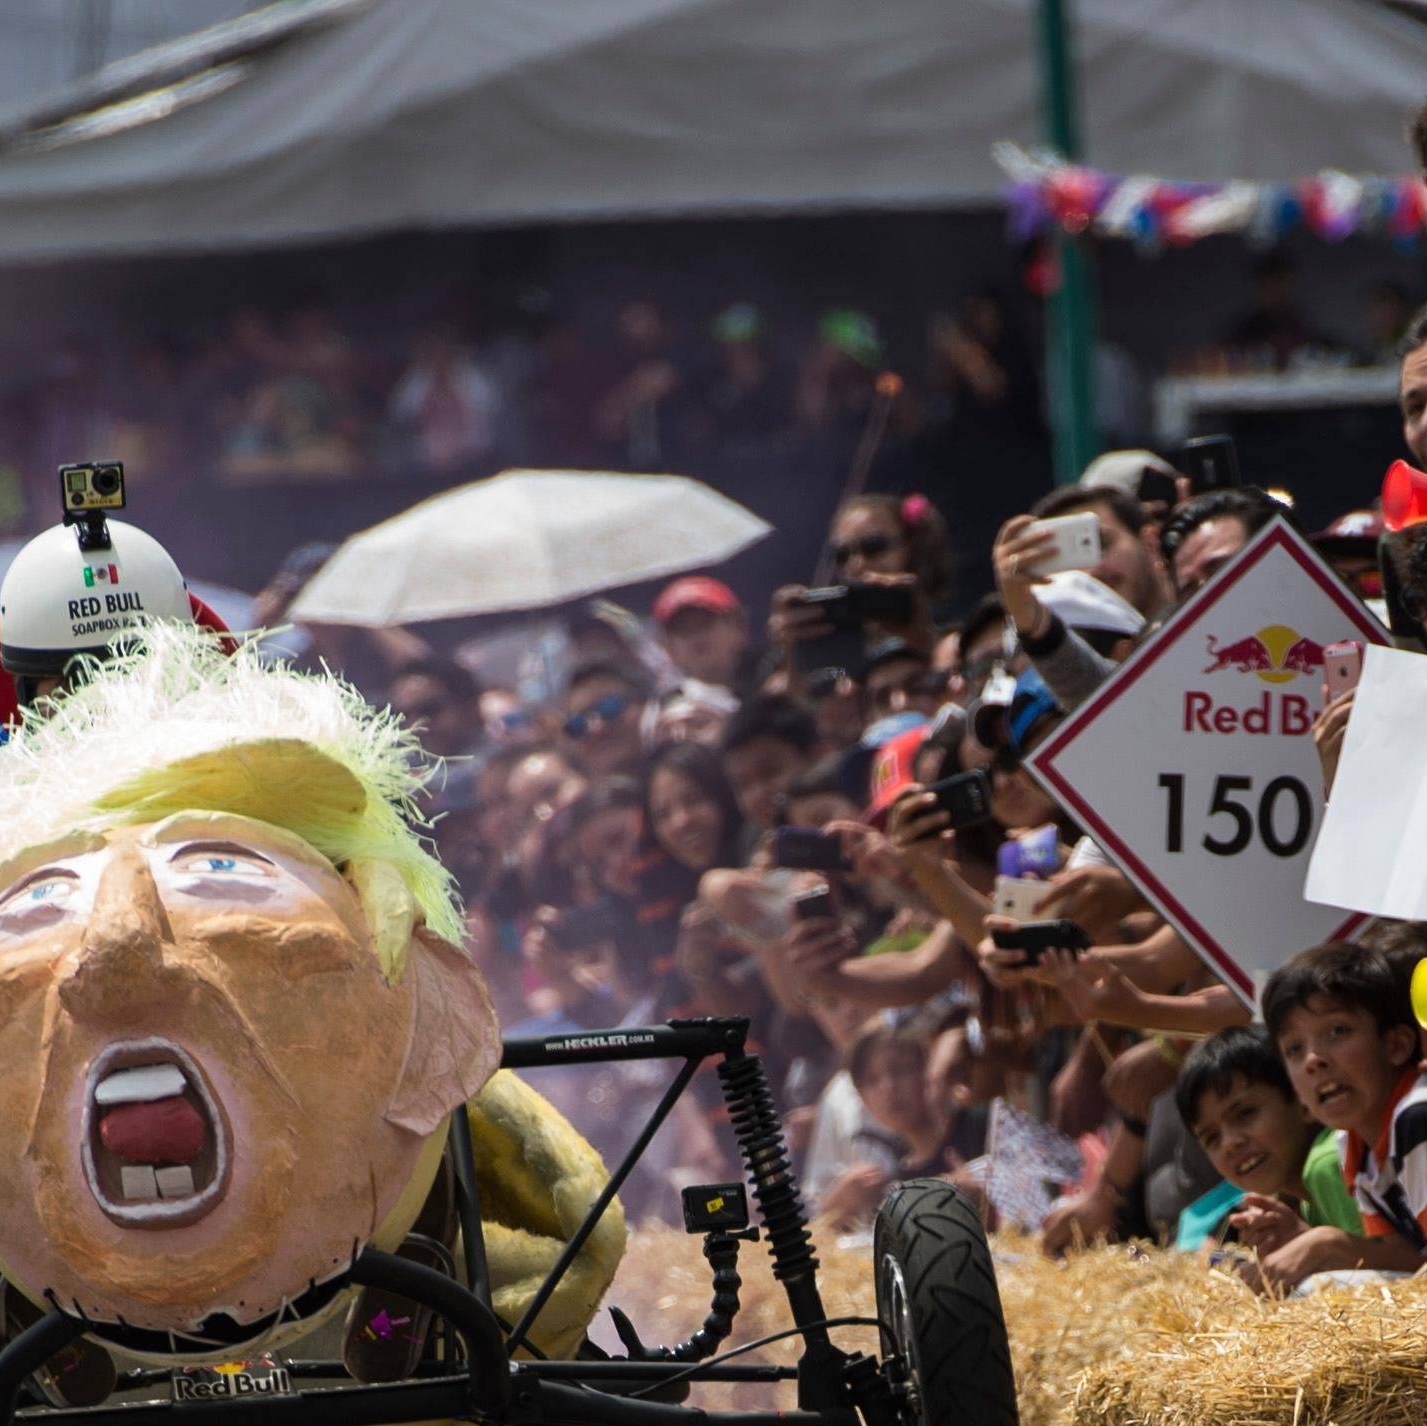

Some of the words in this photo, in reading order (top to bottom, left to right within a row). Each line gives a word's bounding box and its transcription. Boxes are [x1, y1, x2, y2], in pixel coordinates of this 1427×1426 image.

[68, 597, 101, 619] RED
[105, 592, 144, 613] BULL
[72, 617, 121, 636] SOAPBOX
[1183, 690, 1271, 735] Red
[1158, 773, 1314, 858] 150
[175, 1374, 231, 1400] Red
[234, 1367, 291, 1395] Bull
